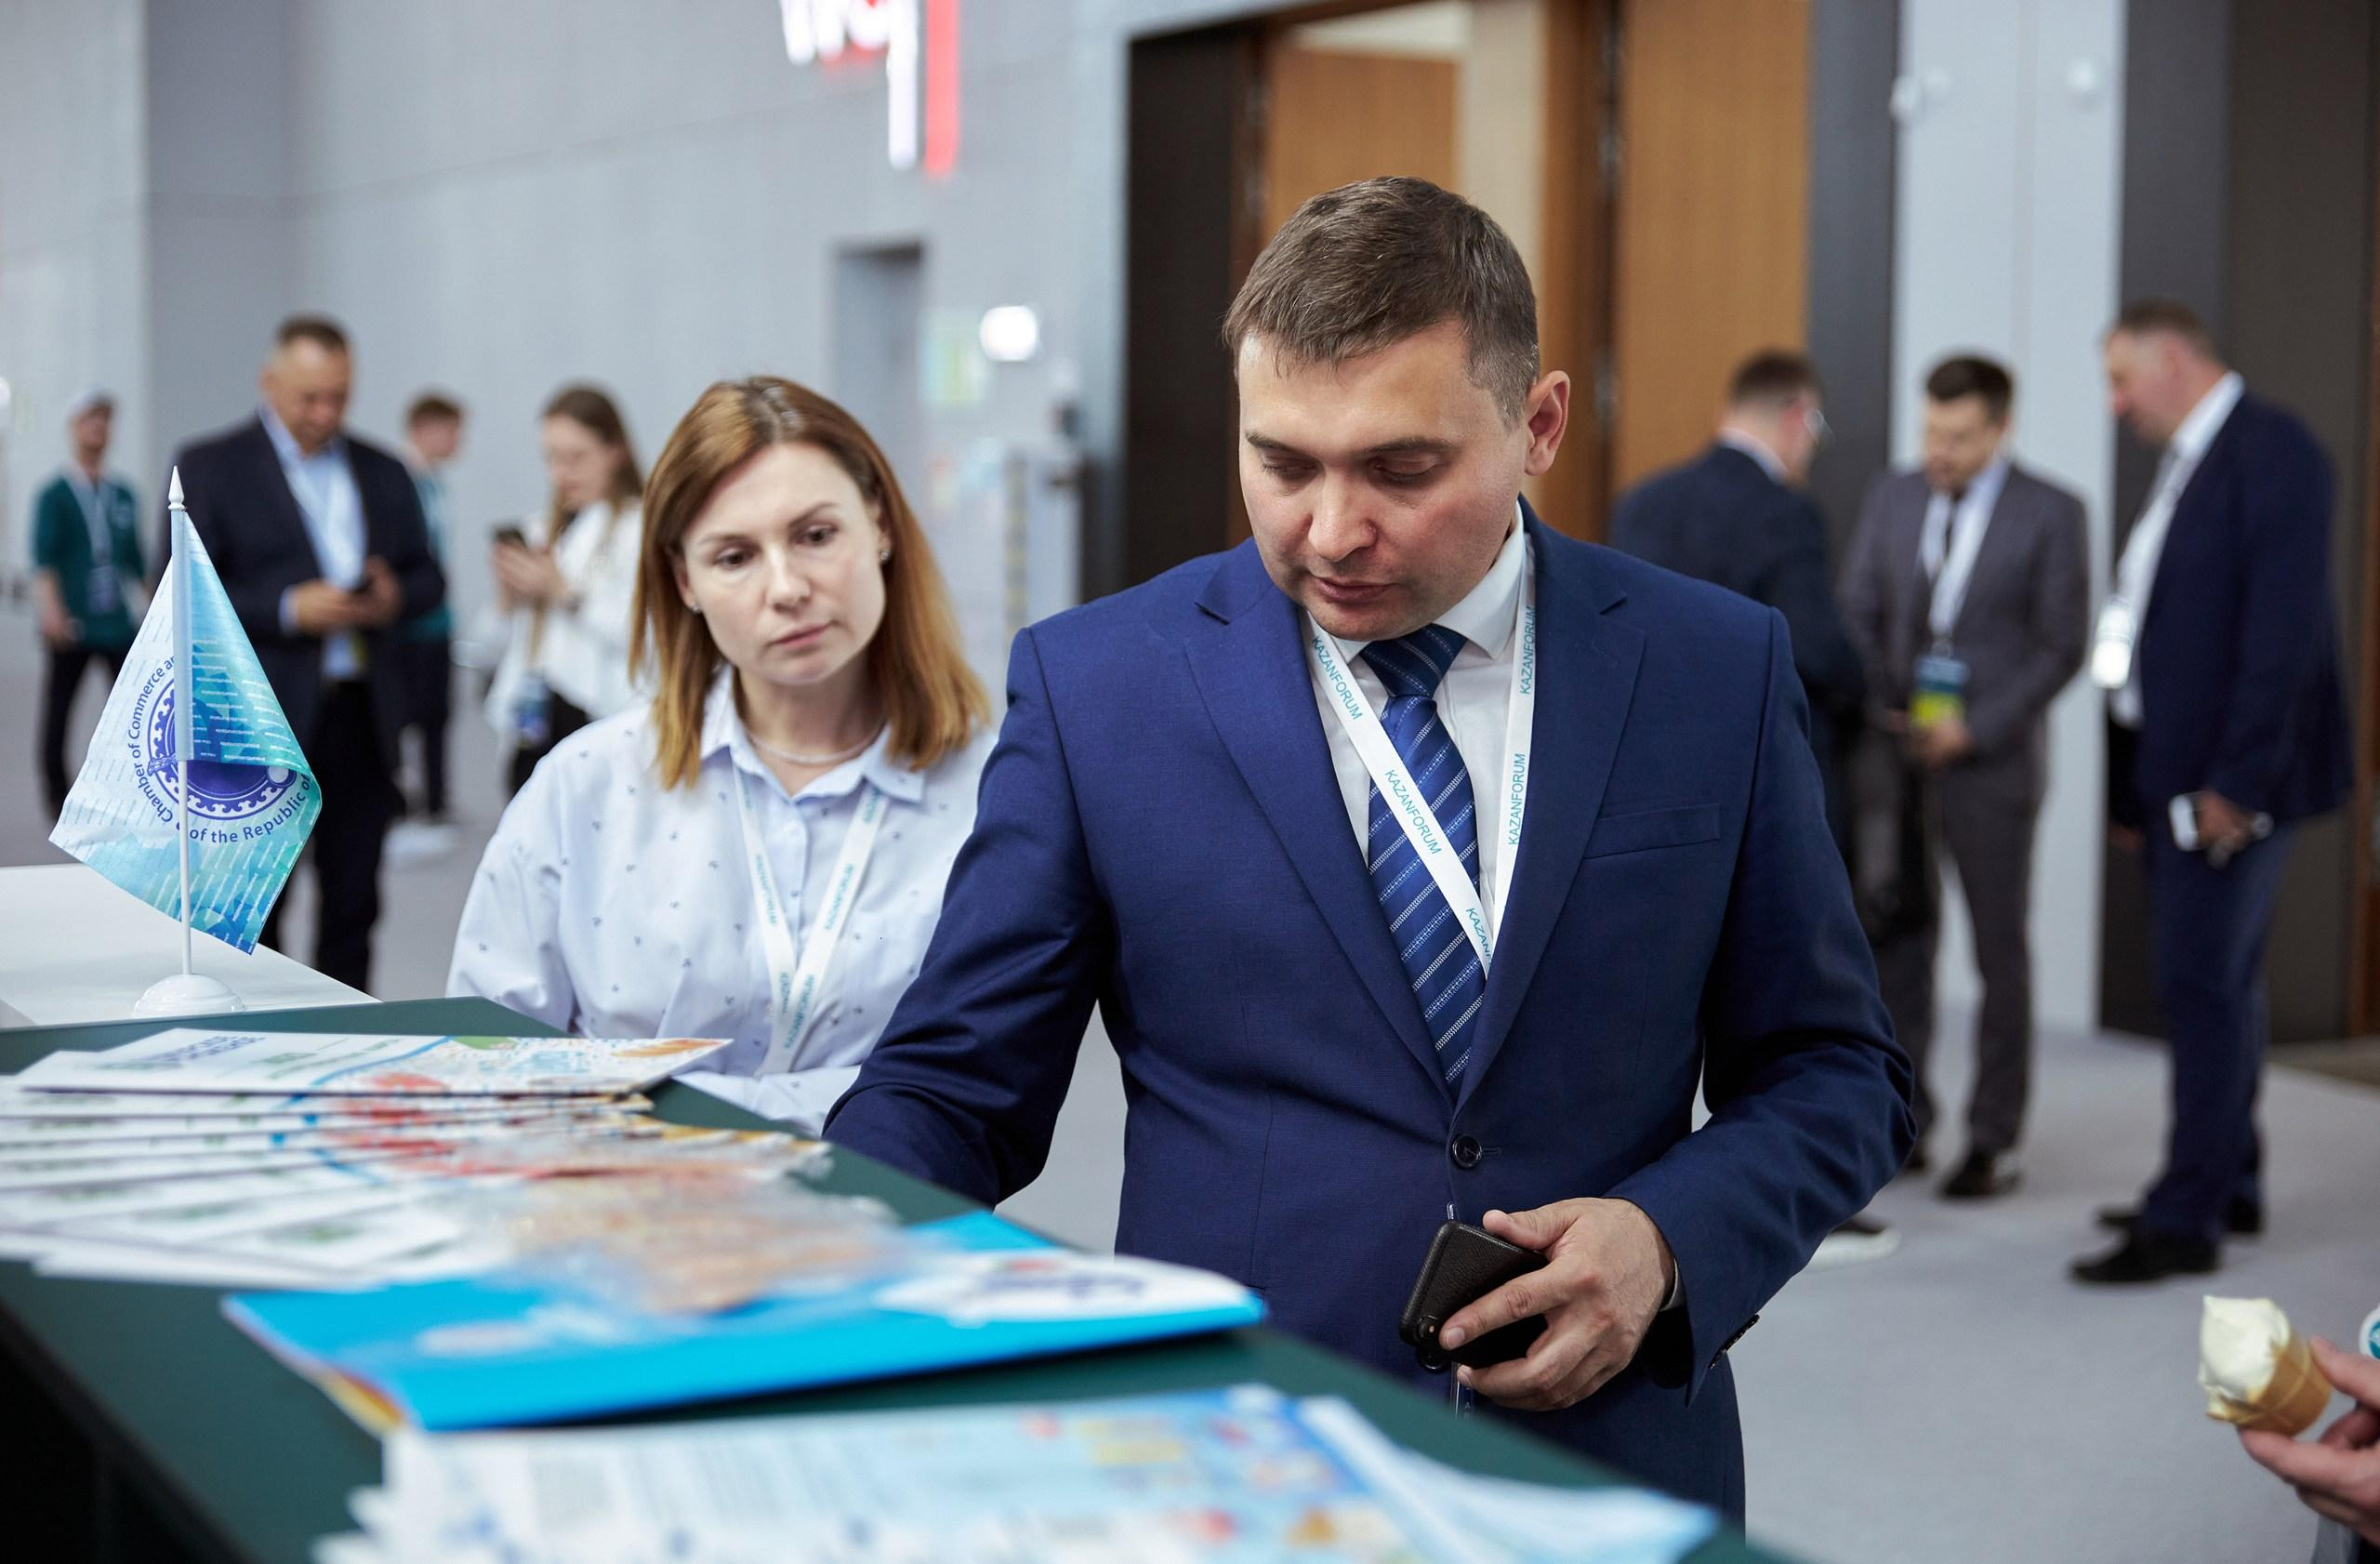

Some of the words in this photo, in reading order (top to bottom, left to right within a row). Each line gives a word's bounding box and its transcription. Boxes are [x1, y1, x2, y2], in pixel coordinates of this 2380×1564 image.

[1312, 635, 1364, 721] KAZANFORUM
[1518, 605, 1536, 696] KAZANFORUM
[128, 666, 165, 740] Commerce
[127, 742, 140, 759] of
[136, 762, 173, 823] Chamber
[189, 828, 207, 842] of
[210, 828, 238, 843] the
[243, 791, 306, 841] Republic
[1384, 769, 1442, 855] KAZANFORUM
[1508, 753, 1526, 845] KAZANFORUM
